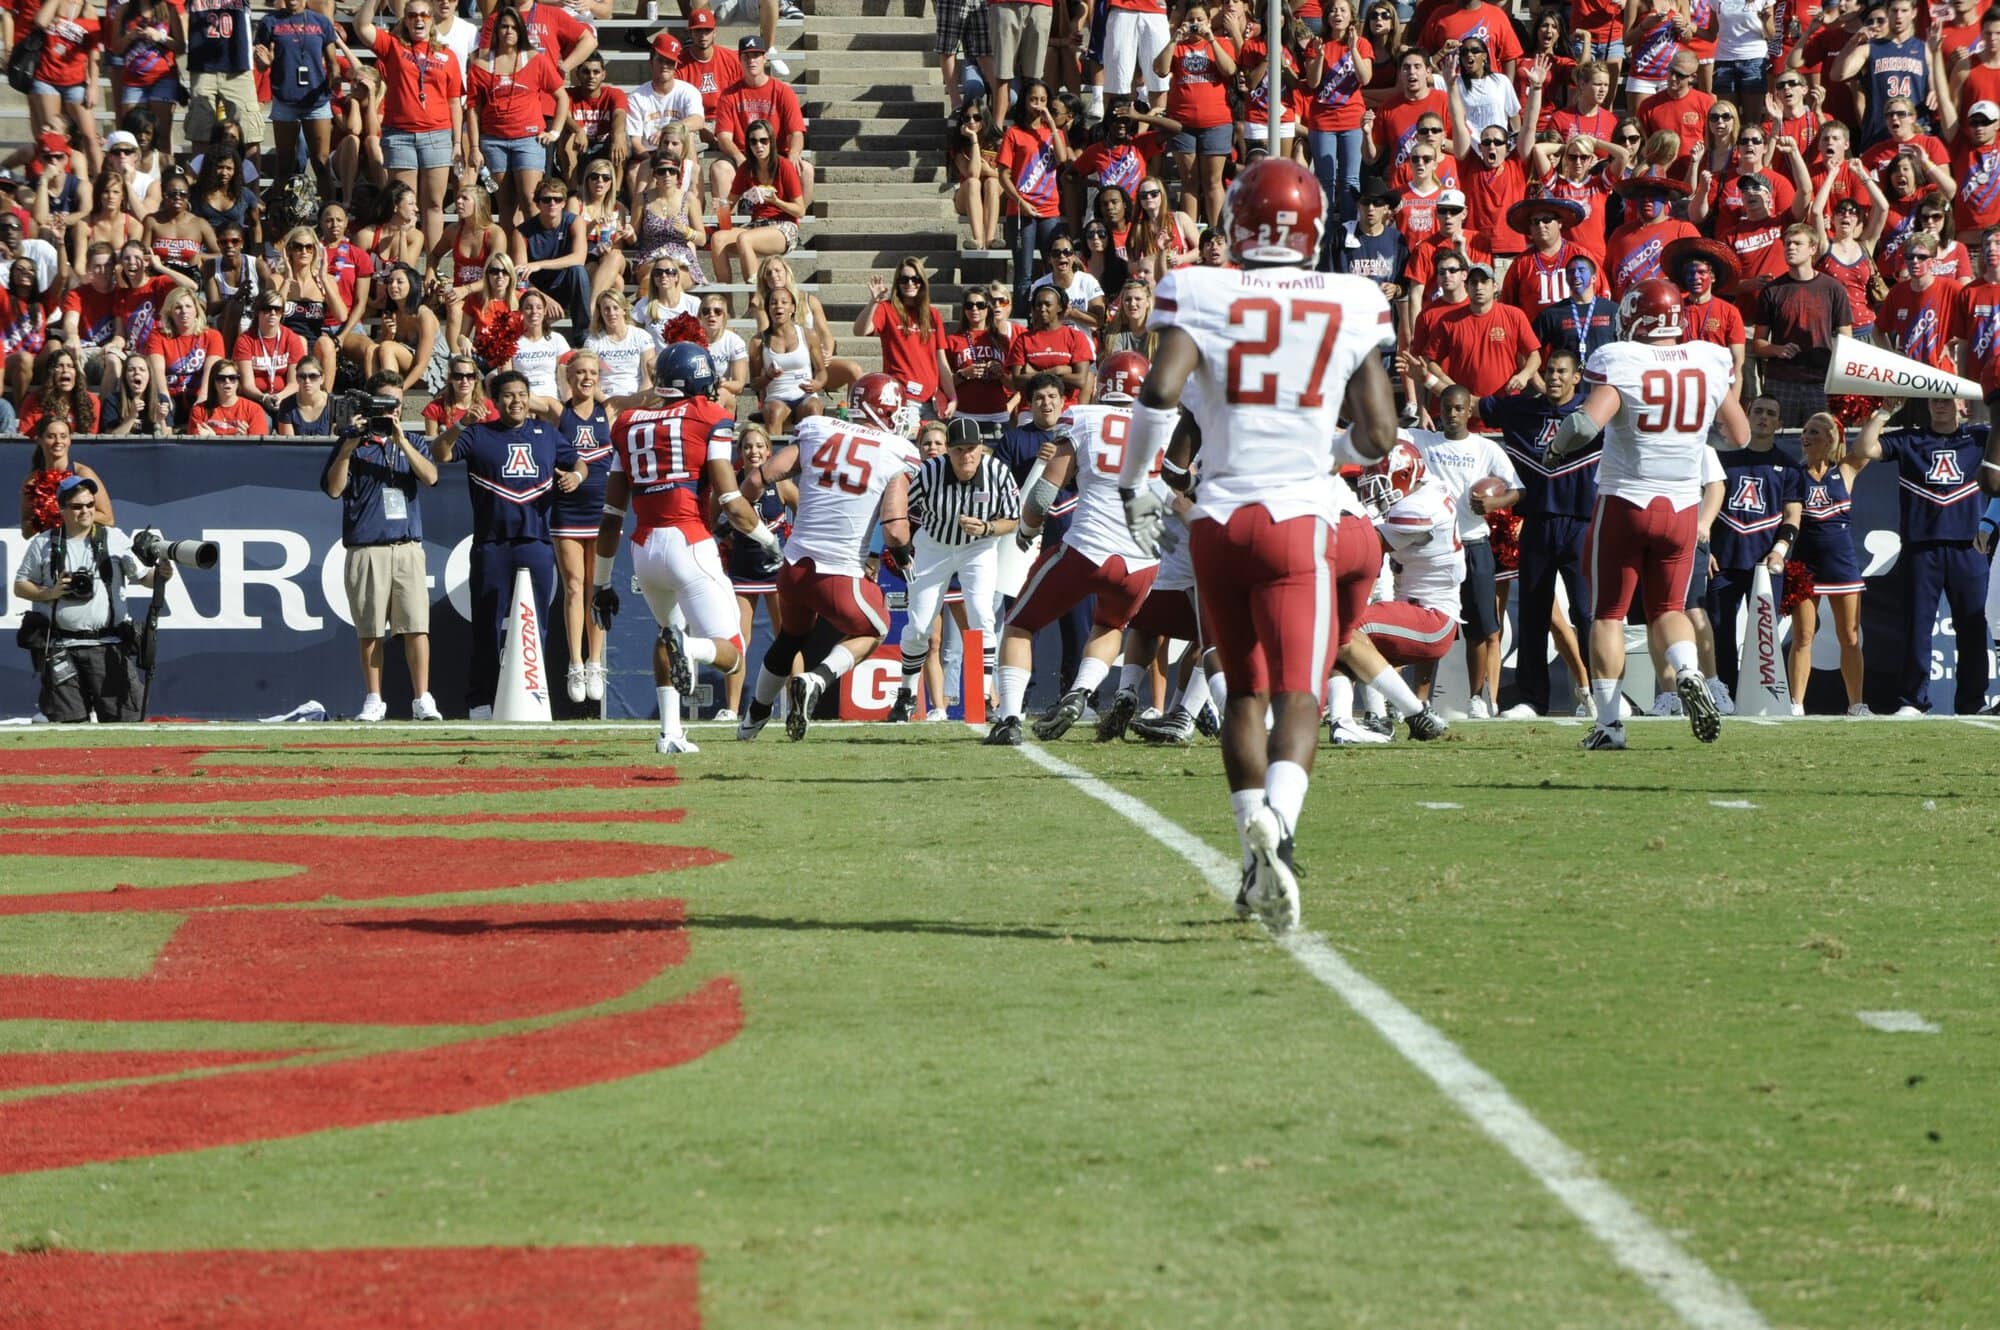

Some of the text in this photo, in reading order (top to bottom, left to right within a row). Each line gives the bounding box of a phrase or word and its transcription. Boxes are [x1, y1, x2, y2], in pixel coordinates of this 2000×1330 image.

[207, 12, 233, 39] 20
[671, 41, 680, 52] T
[1887, 76, 1912, 98] 34
[1257, 224, 1291, 247] 27
[1658, 314, 1678, 327] 90
[694, 355, 711, 378] A
[1227, 296, 1344, 408] 27
[1652, 349, 1689, 362] TURPIN
[1637, 368, 1707, 433] 90
[572, 425, 599, 449] A
[627, 418, 690, 484] 81
[502, 443, 539, 478] A
[811, 432, 881, 496] 45
[1925, 450, 1964, 484] A
[1728, 475, 1766, 514] A
[1805, 485, 1832, 508] A
[519, 601, 539, 690] ARIZONA
[1757, 595, 1775, 685] ARIZONA
[851, 658, 904, 710] G
